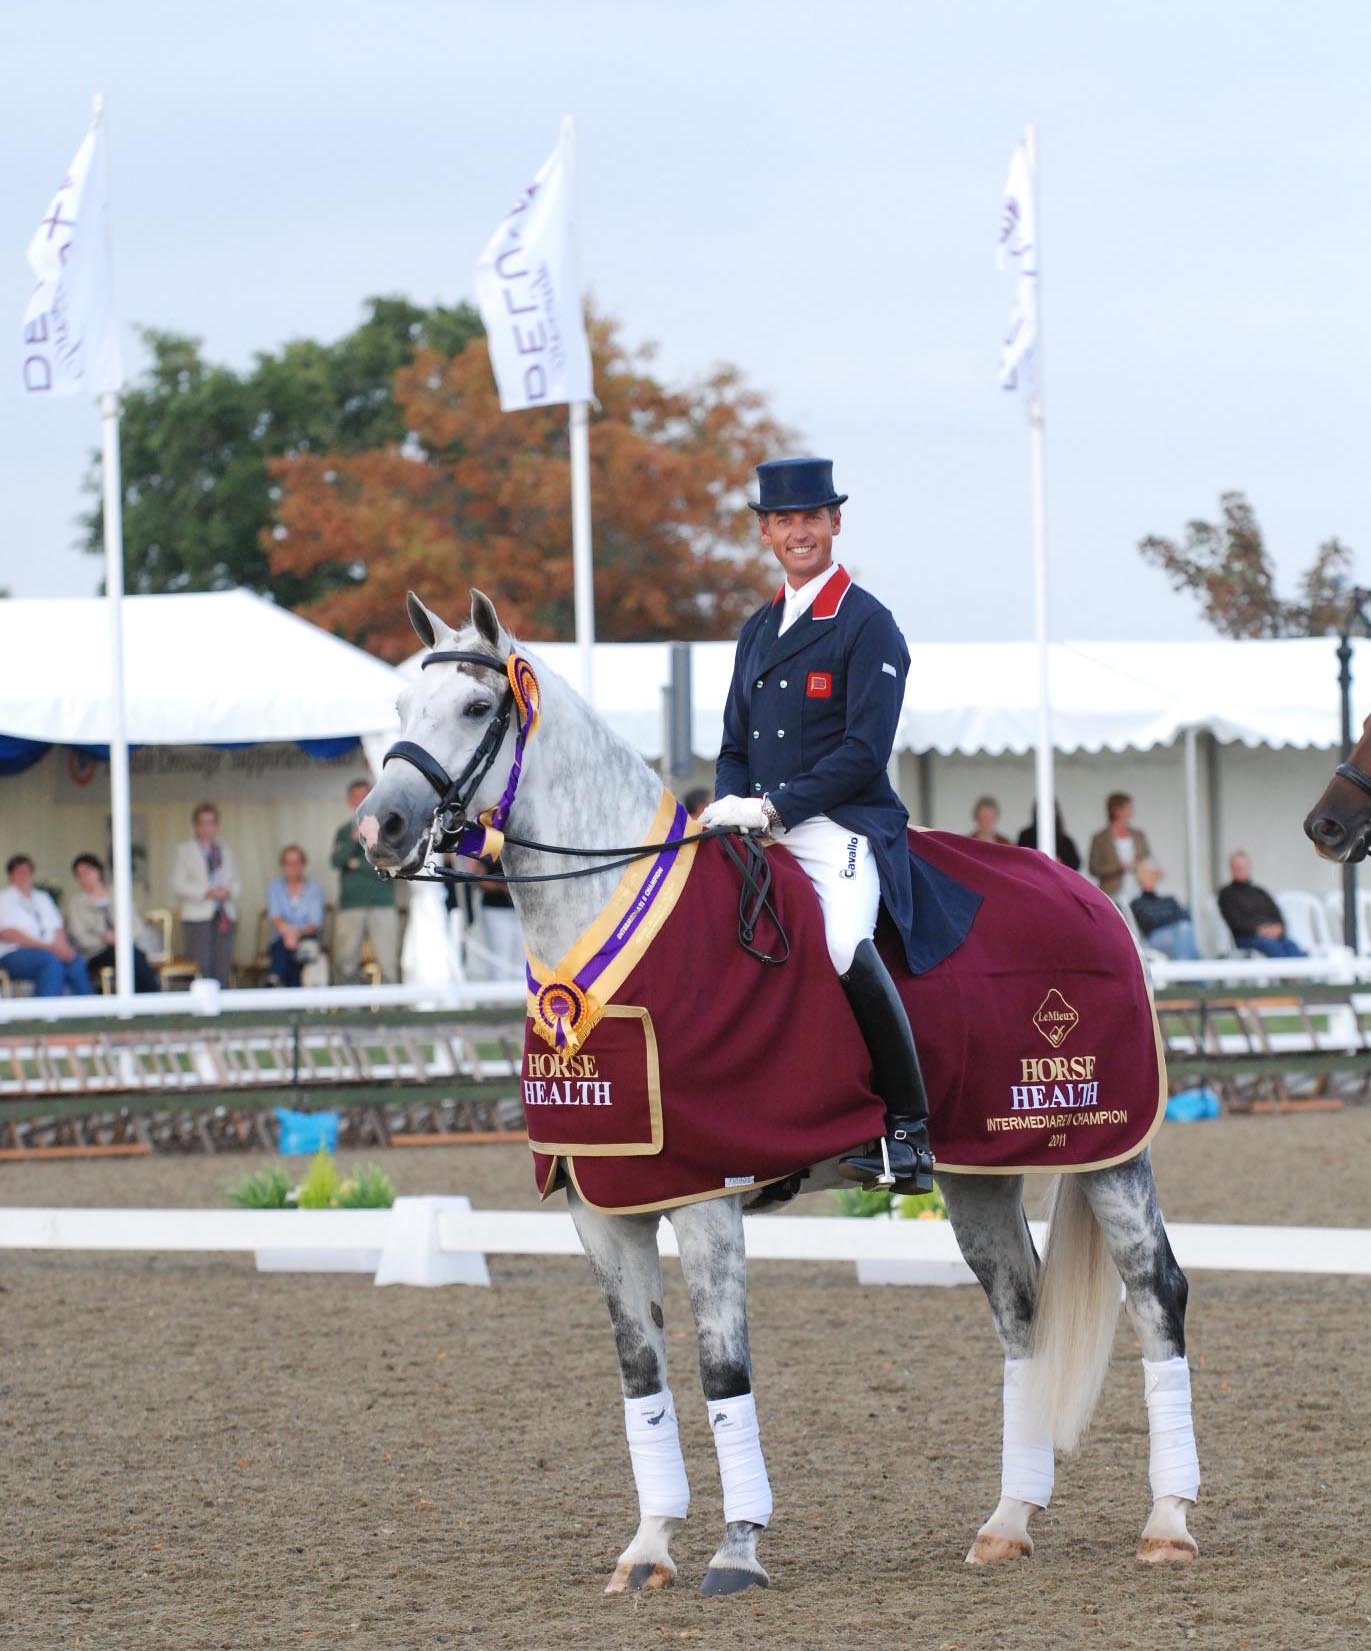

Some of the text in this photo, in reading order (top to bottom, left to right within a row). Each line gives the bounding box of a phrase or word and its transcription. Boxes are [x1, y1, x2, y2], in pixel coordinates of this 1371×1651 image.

[843, 836, 859, 879] Cavallo
[644, 866, 665, 897] CHAMPION
[1038, 1010, 1075, 1023] LeMieux
[527, 1053, 599, 1078] HORSE
[1020, 1055, 1096, 1083] HORSE
[523, 1080, 613, 1106] HEALTH
[1010, 1081, 1100, 1110] HEALTH
[1072, 1109, 1128, 1126] CHAMPION
[1047, 1132, 1067, 1148] 2011
